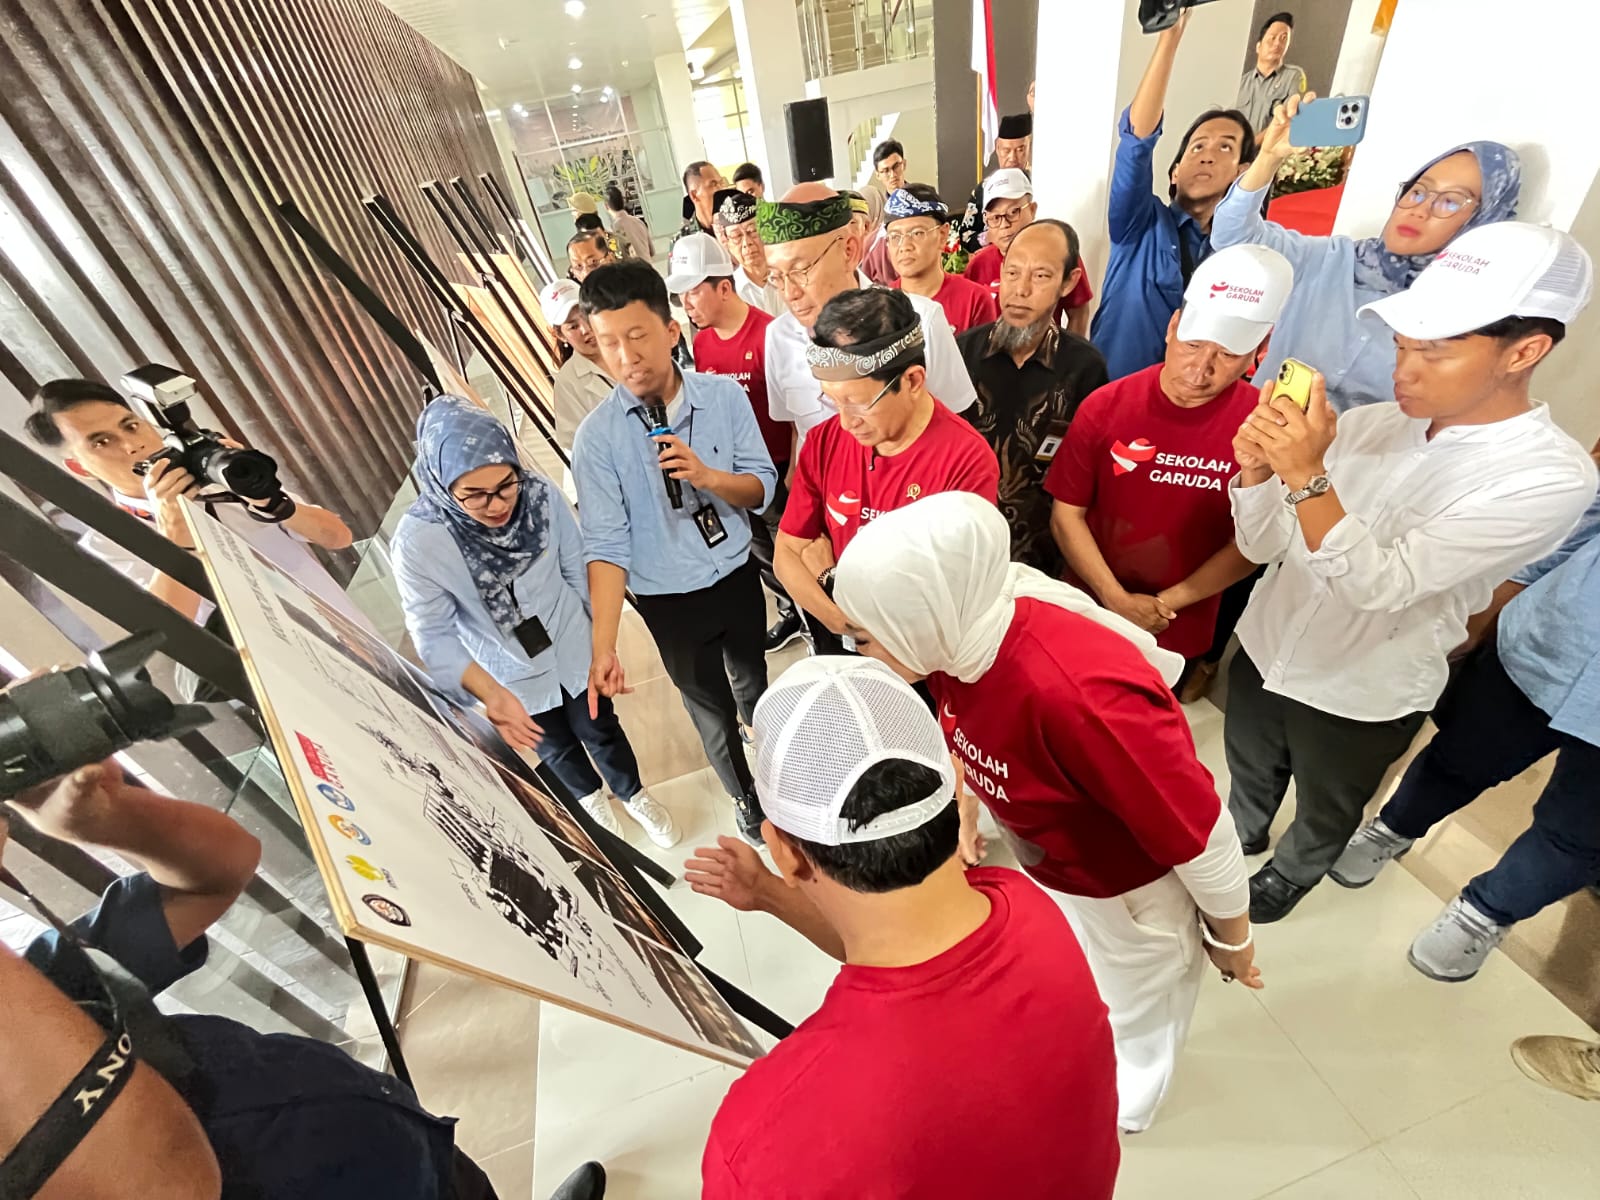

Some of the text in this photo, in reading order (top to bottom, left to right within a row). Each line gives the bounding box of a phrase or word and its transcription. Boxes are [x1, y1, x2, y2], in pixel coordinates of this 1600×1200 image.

[1226, 292, 1260, 304] GARUDA
[1229, 285, 1264, 297] SEKOLAH
[1155, 453, 1231, 473] SEKOLAH
[1149, 469, 1221, 491] GARUDA
[953, 727, 1009, 779] SEKOLAH
[73, 1033, 132, 1116] ONY
